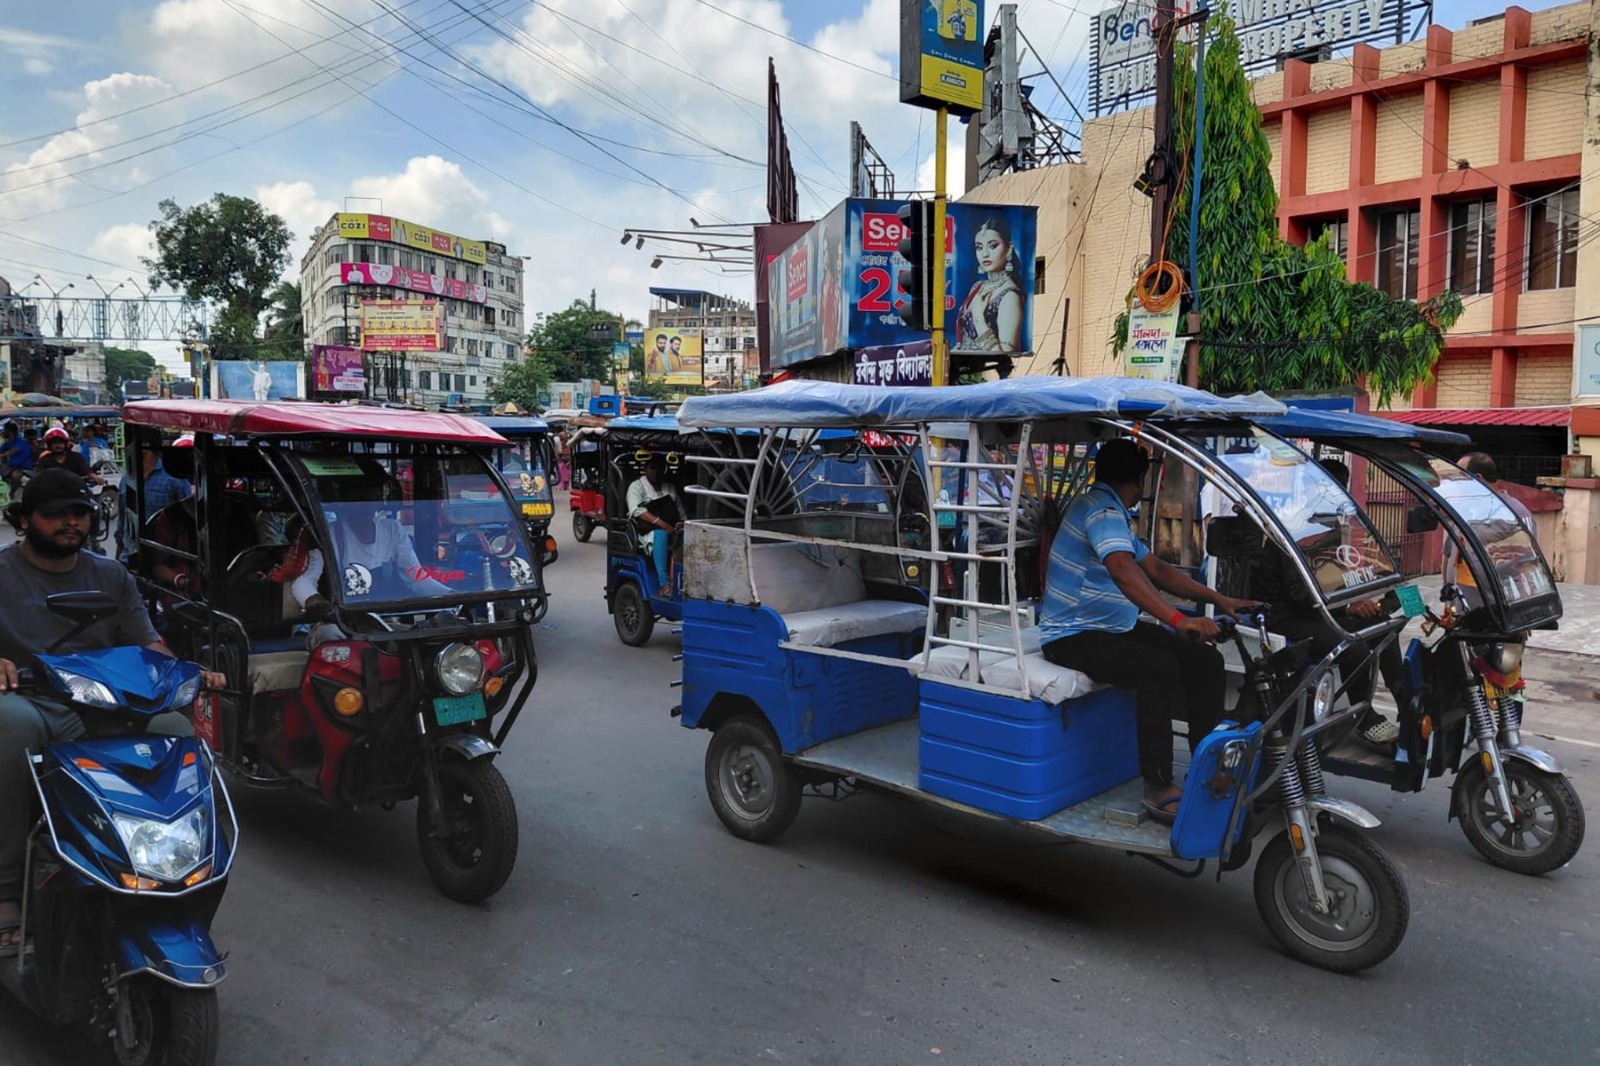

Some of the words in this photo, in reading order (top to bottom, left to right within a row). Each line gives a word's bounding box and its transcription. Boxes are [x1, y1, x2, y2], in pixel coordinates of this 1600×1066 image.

[1240, 0, 1385, 63] ROPERTY
[340, 222, 366, 230] COZI
[413, 231, 431, 243] COZI
[469, 247, 484, 258] COZI
[788, 259, 807, 289] Senco
[1342, 564, 1377, 588] KINETIC
